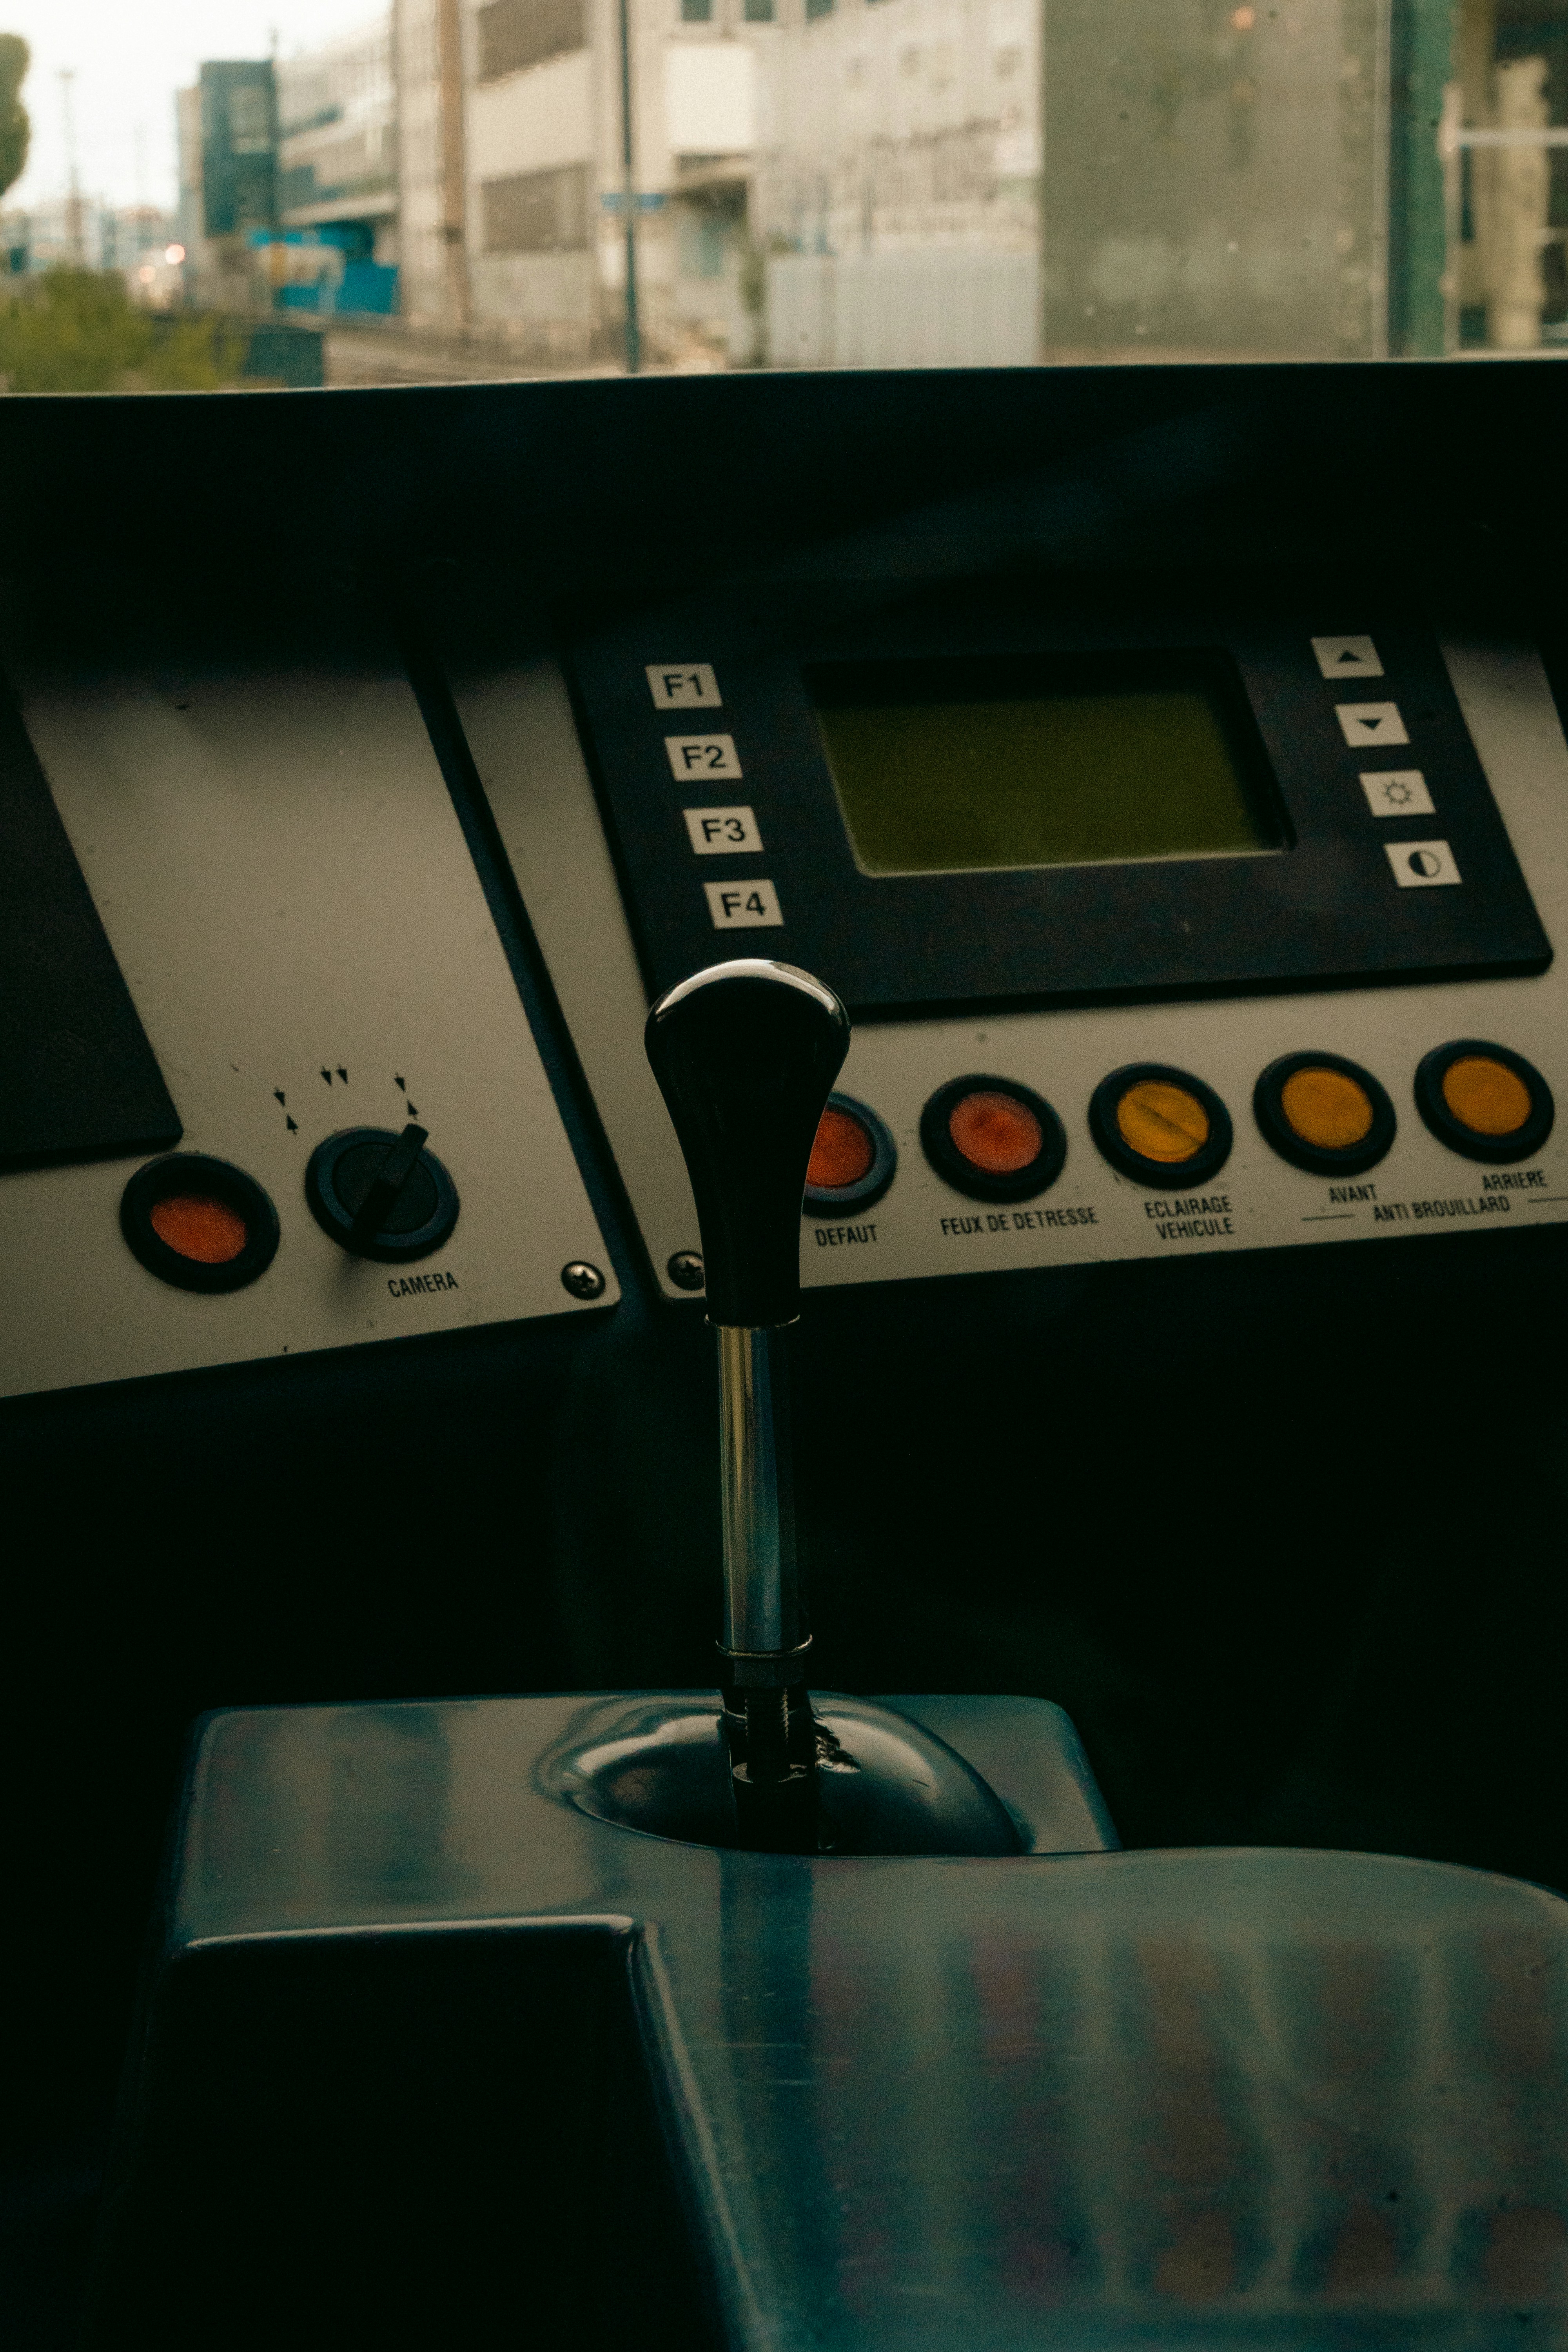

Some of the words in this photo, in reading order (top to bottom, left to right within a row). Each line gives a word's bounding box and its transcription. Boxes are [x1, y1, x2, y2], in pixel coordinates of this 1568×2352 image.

[662, 673, 703, 697] F1
[681, 745, 726, 769] F2
[701, 818, 746, 843] F3
[720, 892, 766, 917] F4
[1482, 1170, 1547, 1191] ARRIERE
[1329, 1184, 1377, 1203] AVANT
[1144, 1196, 1233, 1218] ECLAIRAGE
[1374, 1203, 1409, 1221] ANTI
[1411, 1195, 1511, 1219] BROUILLARD
[941, 1216, 984, 1236] FEUX
[987, 1213, 1010, 1232] DE
[1014, 1206, 1098, 1230] DETRESSE
[1156, 1218, 1234, 1240] VEHICULE
[815, 1225, 877, 1247] DEFAUT
[387, 1272, 459, 1298] CAMERA
